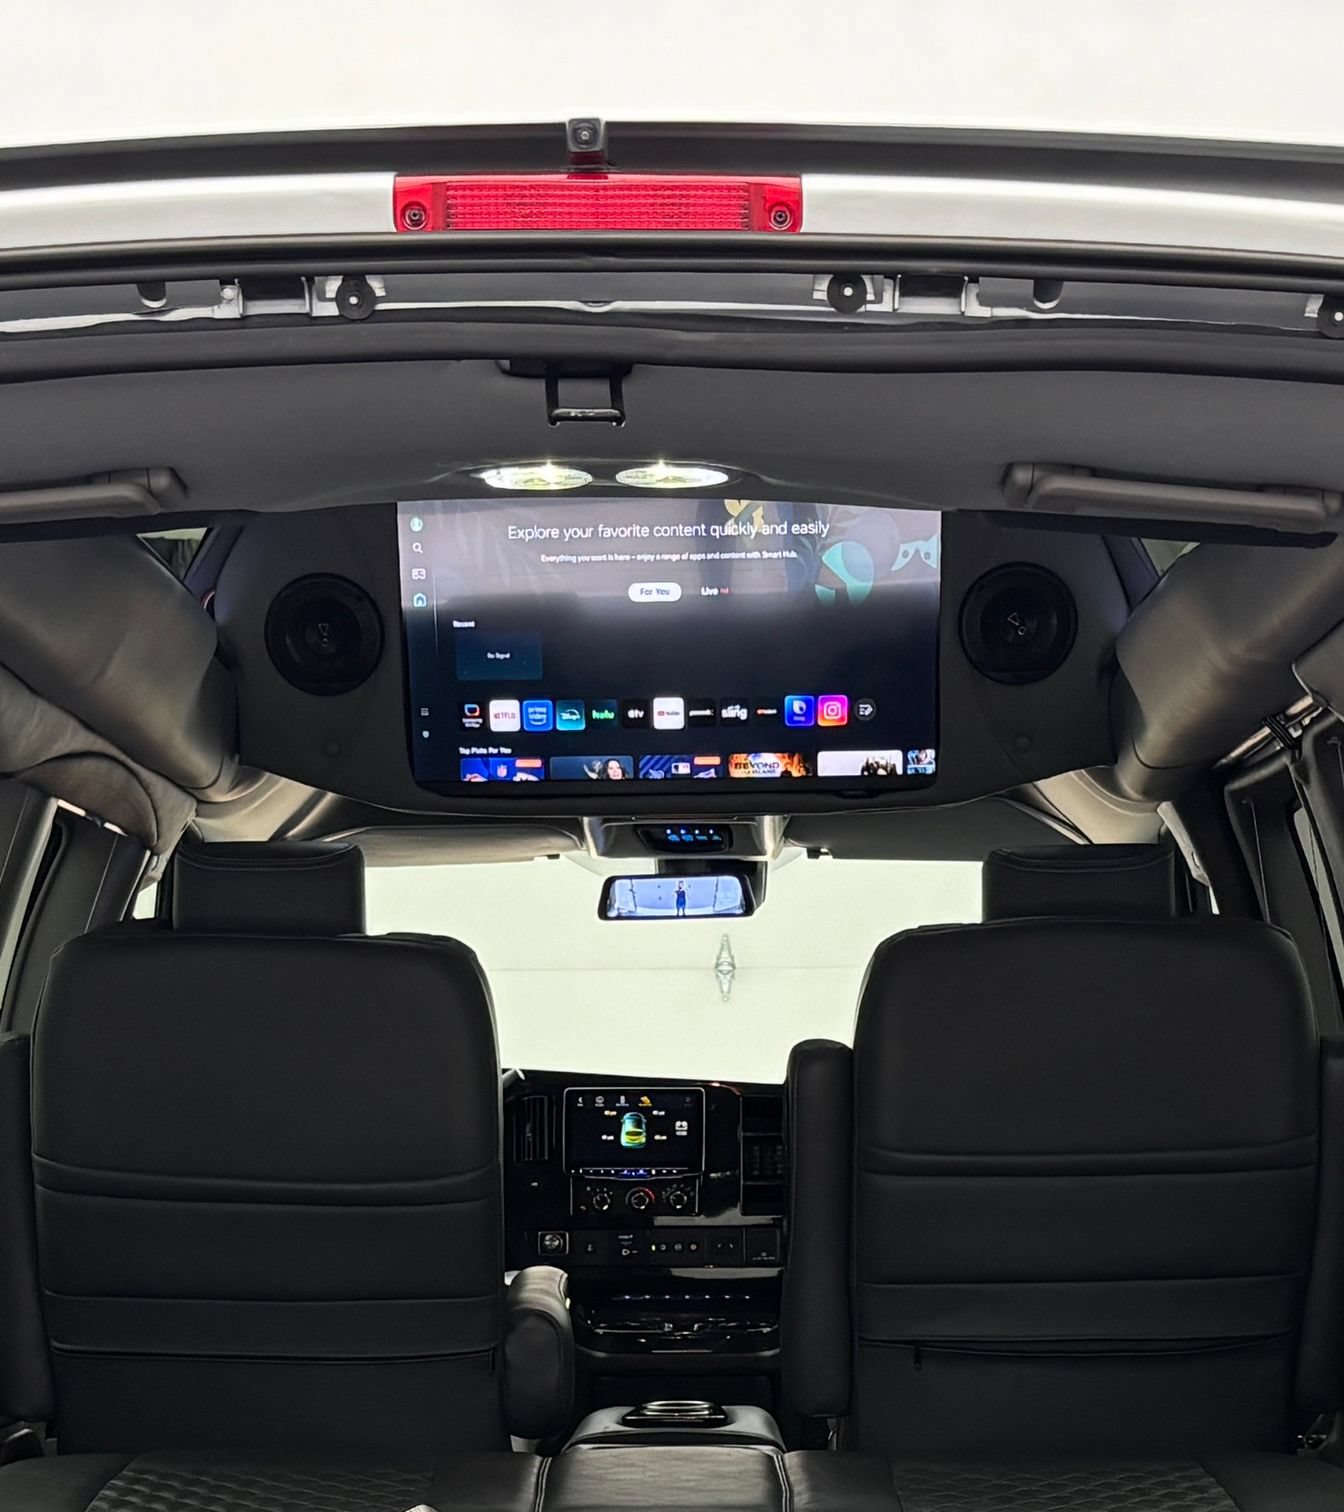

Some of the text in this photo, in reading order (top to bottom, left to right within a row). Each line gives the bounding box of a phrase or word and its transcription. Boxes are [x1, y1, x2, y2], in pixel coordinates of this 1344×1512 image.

[508, 521, 830, 542] Explore your favorite content quickly and easily
[640, 587, 670, 596] For You
[701, 587, 719, 596] Live
[721, 705, 747, 720] sling
